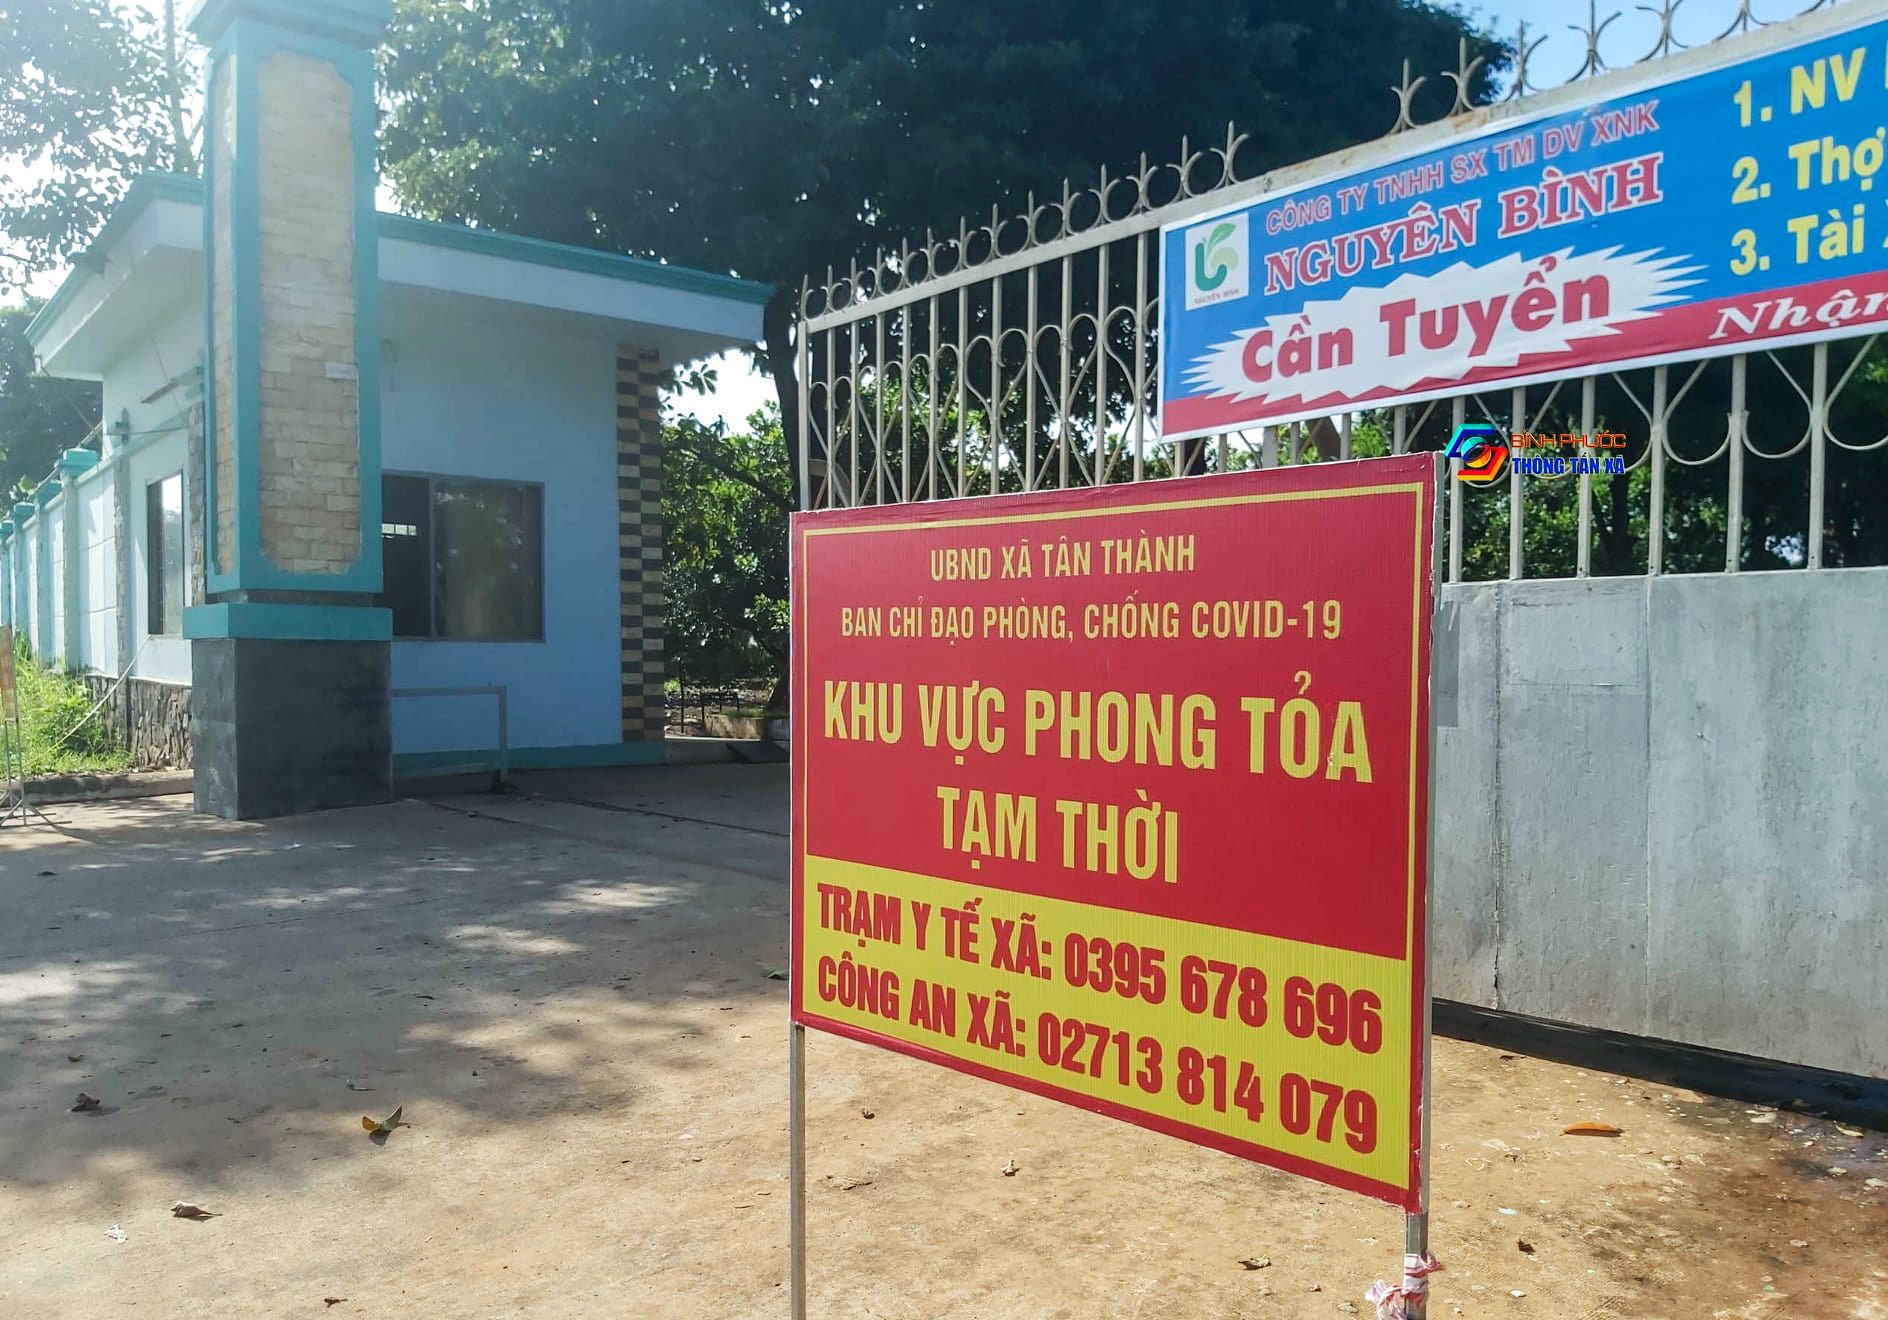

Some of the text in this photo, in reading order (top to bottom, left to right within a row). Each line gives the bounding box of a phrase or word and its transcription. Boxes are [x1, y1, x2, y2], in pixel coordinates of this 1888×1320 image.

[1733, 79, 1773, 128] 1.
[1790, 47, 1866, 115] NV
[1266, 99, 1660, 236] CÔNG TY TNHH SX TM DV XNK
[1731, 126, 1886, 204] 2. Thợ
[1264, 151, 1664, 296] NGUYÊN BÌNH
[1730, 228, 1770, 276] 3.
[1787, 203, 1865, 265] Tài
[1242, 256, 1610, 383] Cần Tuyển
[930, 534, 1195, 582] UBND XÃ TÂN THÀNH
[841, 590, 1342, 647] BAN CHỈ ĐẠO PHÒNG, CHỐNG COVID-19
[824, 670, 1373, 784] KHU VỰC PHONG TỎA
[937, 786, 1179, 885] TẠM THỜI
[818, 883, 1383, 1055] TRẠM Y TẾ XÃ: 0395 678 696
[818, 955, 1378, 1155] CÔNG AN XÃ: 02713 814 079
